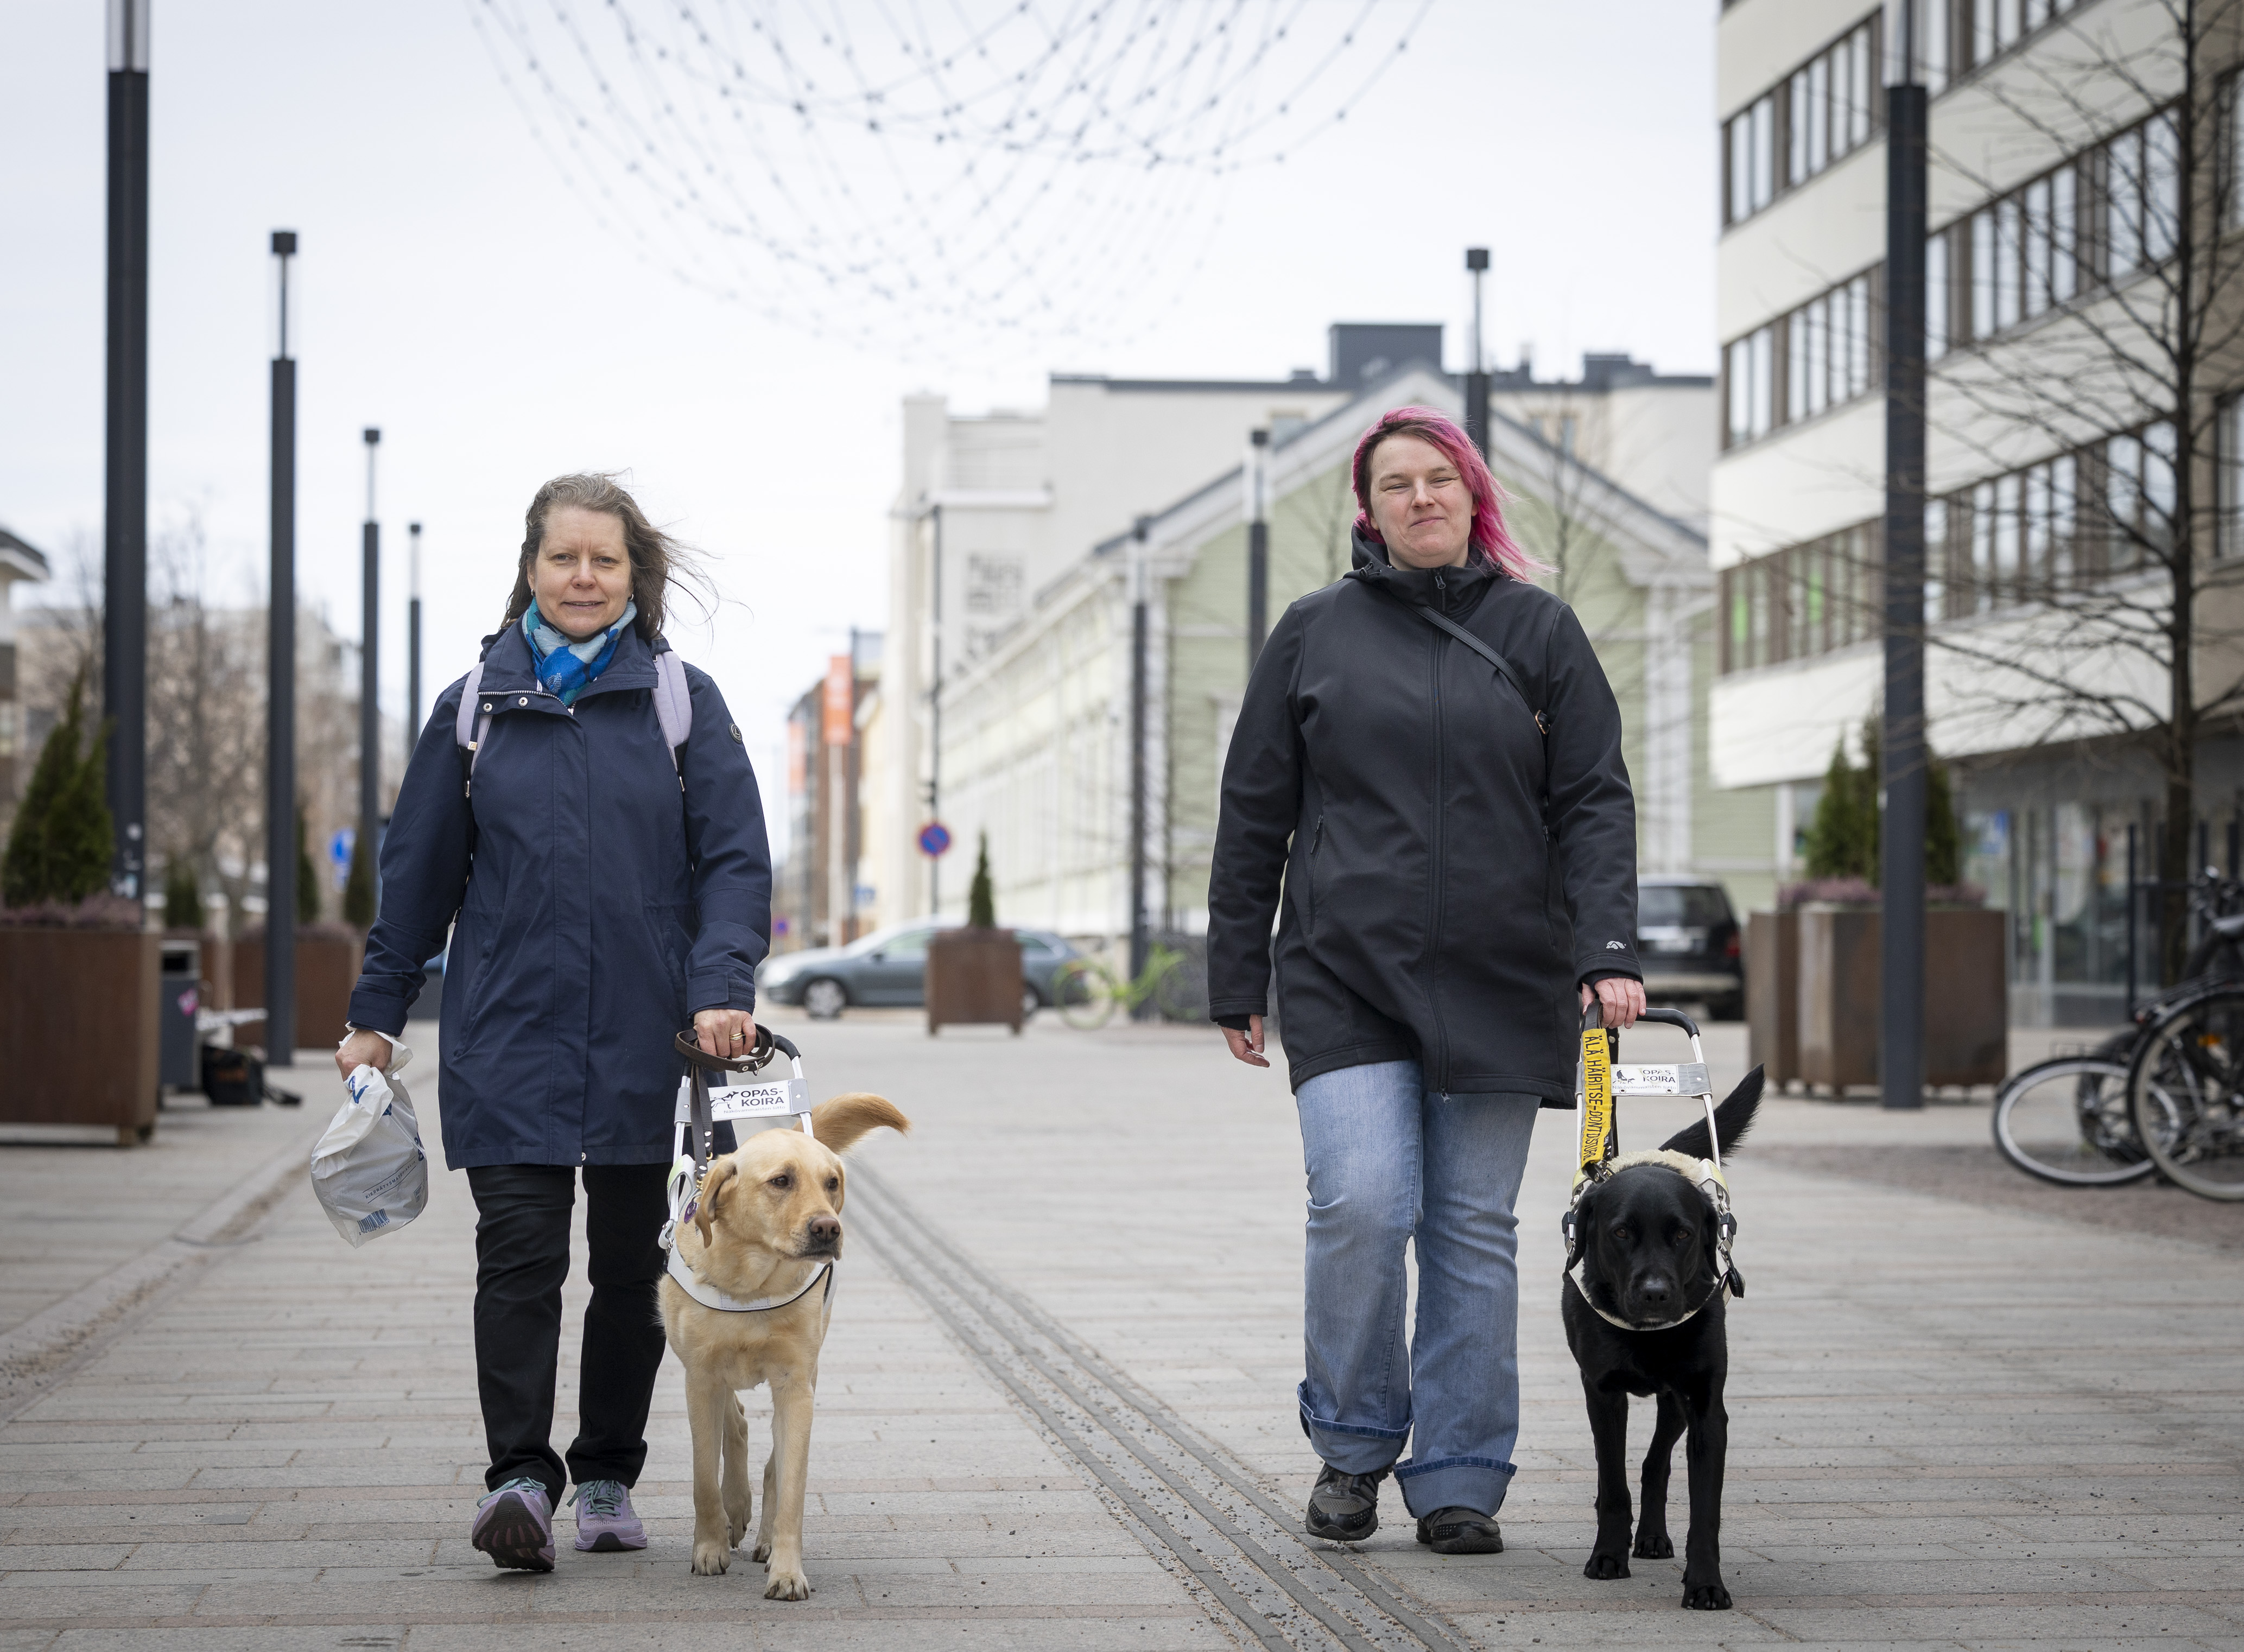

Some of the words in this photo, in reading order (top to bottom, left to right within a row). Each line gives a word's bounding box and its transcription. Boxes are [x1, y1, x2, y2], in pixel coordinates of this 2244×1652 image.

[1584, 1035, 1604, 1056] ÄLÄ
[740, 1088, 784, 1098] OPAS-
[741, 1096, 784, 1107] KOIRA
